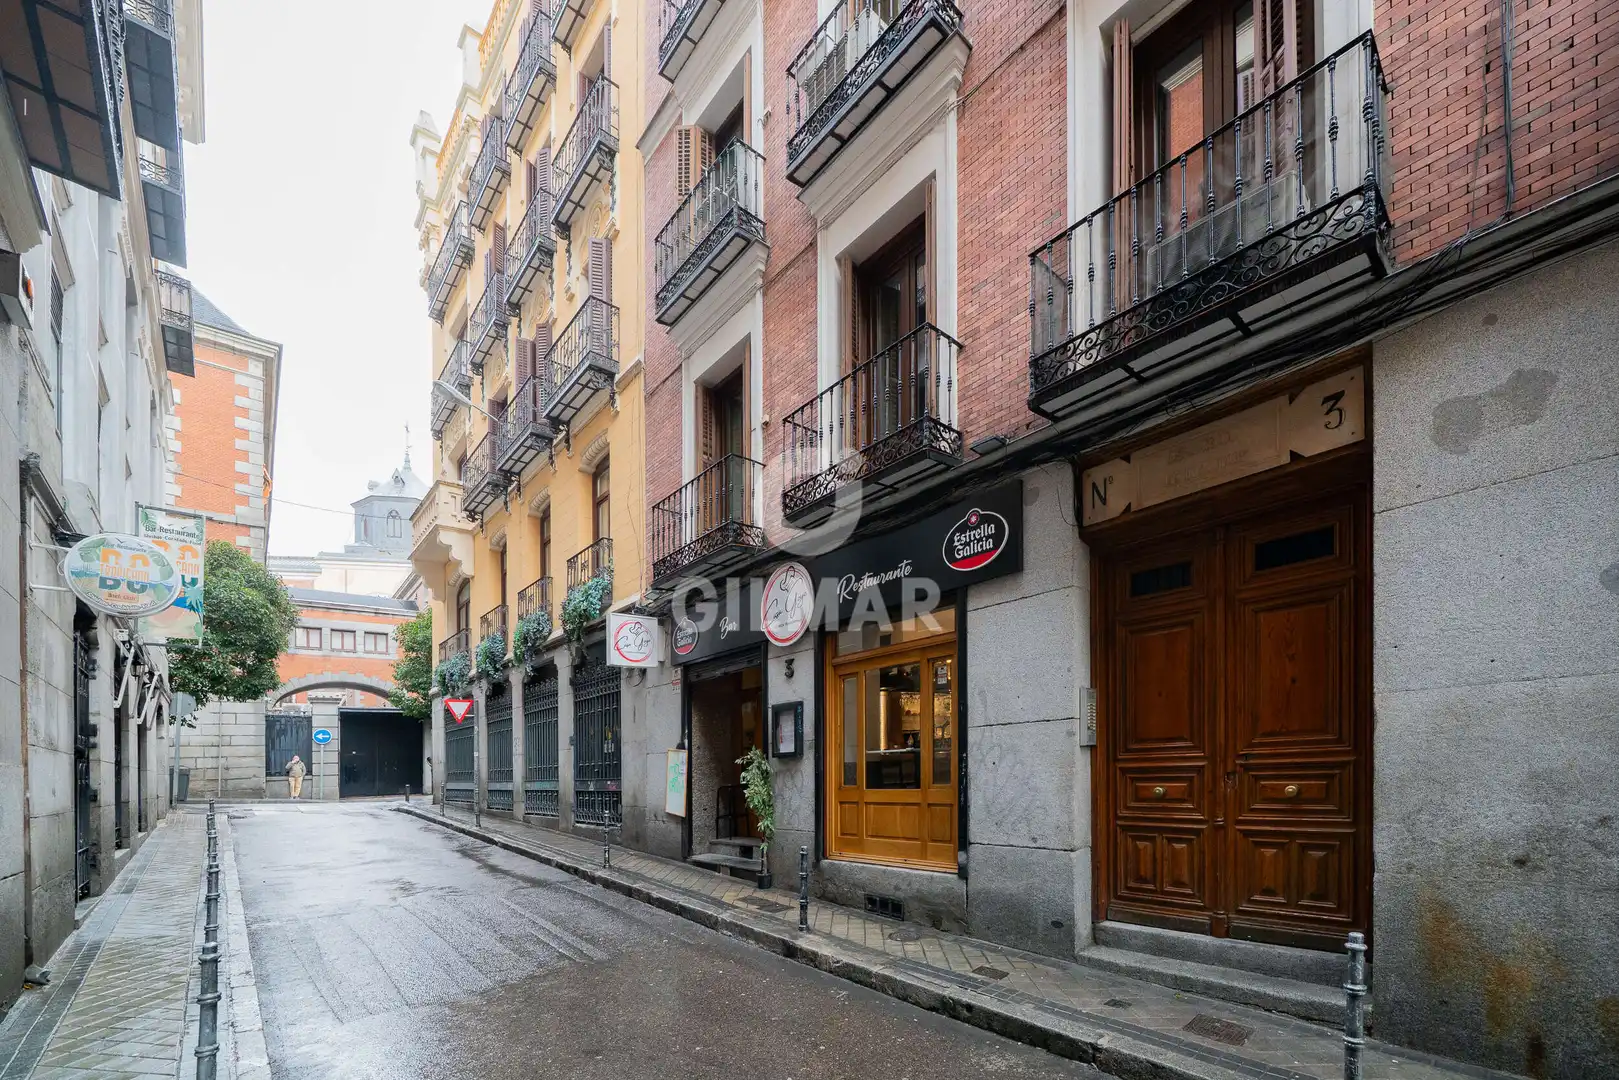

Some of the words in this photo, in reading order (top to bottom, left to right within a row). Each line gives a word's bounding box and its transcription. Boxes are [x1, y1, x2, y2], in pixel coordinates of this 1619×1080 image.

[1320, 389, 1347, 430] 3
[953, 523, 996, 547] Estrella
[954, 537, 994, 559] Galicia
[837, 560, 913, 604] Restaurante
[719, 616, 738, 640] Bar
